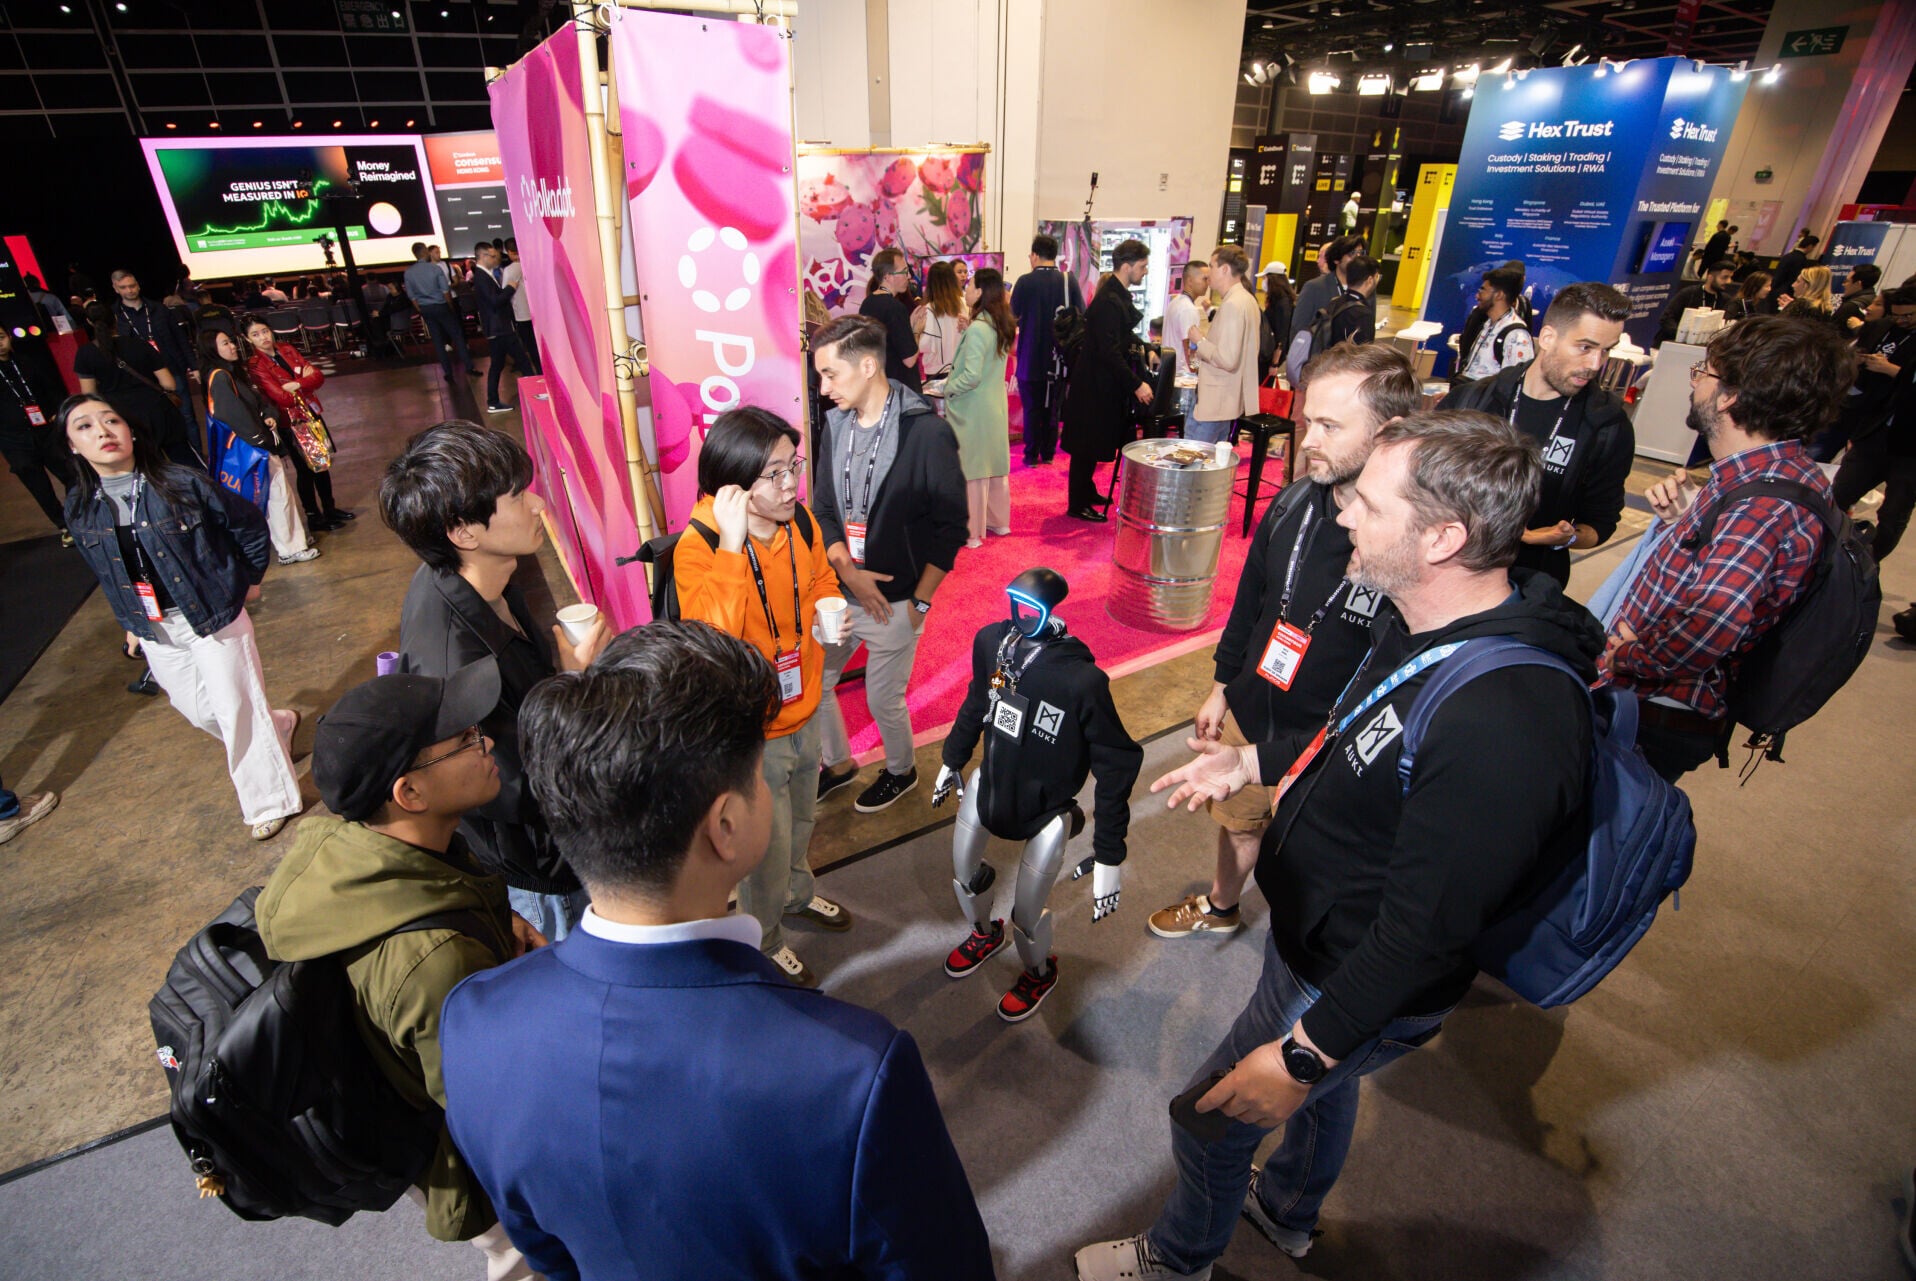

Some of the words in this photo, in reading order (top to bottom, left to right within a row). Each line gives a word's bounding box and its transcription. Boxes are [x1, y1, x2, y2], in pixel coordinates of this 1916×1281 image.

[1528, 122, 1563, 138] Hex
[1564, 120, 1614, 137] Trust
[1683, 122, 1699, 140] Hex
[1699, 124, 1718, 142] Trust
[1487, 154, 1522, 164] Custody
[1528, 153, 1561, 163] Staking
[1569, 152, 1606, 163] Trading
[356, 161, 389, 171] Money
[1487, 165, 1533, 173] Investment
[1535, 164, 1576, 173] Solutions
[1583, 164, 1605, 173] RWA
[359, 170, 416, 182] Reimagined
[230, 181, 271, 192] GENIUS
[272, 180, 298, 190] ISN'T
[222, 191, 282, 202] MEASURED
[283, 190, 295, 199] IN
[532, 175, 576, 219] Polkadot
[1638, 200, 1649, 212] The
[1649, 201, 1669, 213] Trusted
[1670, 202, 1691, 213] Platform
[1844, 246, 1858, 256] Hex
[1858, 246, 1876, 256] Trust
[1340, 611, 1373, 628] AUKI
[1031, 727, 1057, 745] AUKI
[1344, 743, 1363, 777] AUKI
